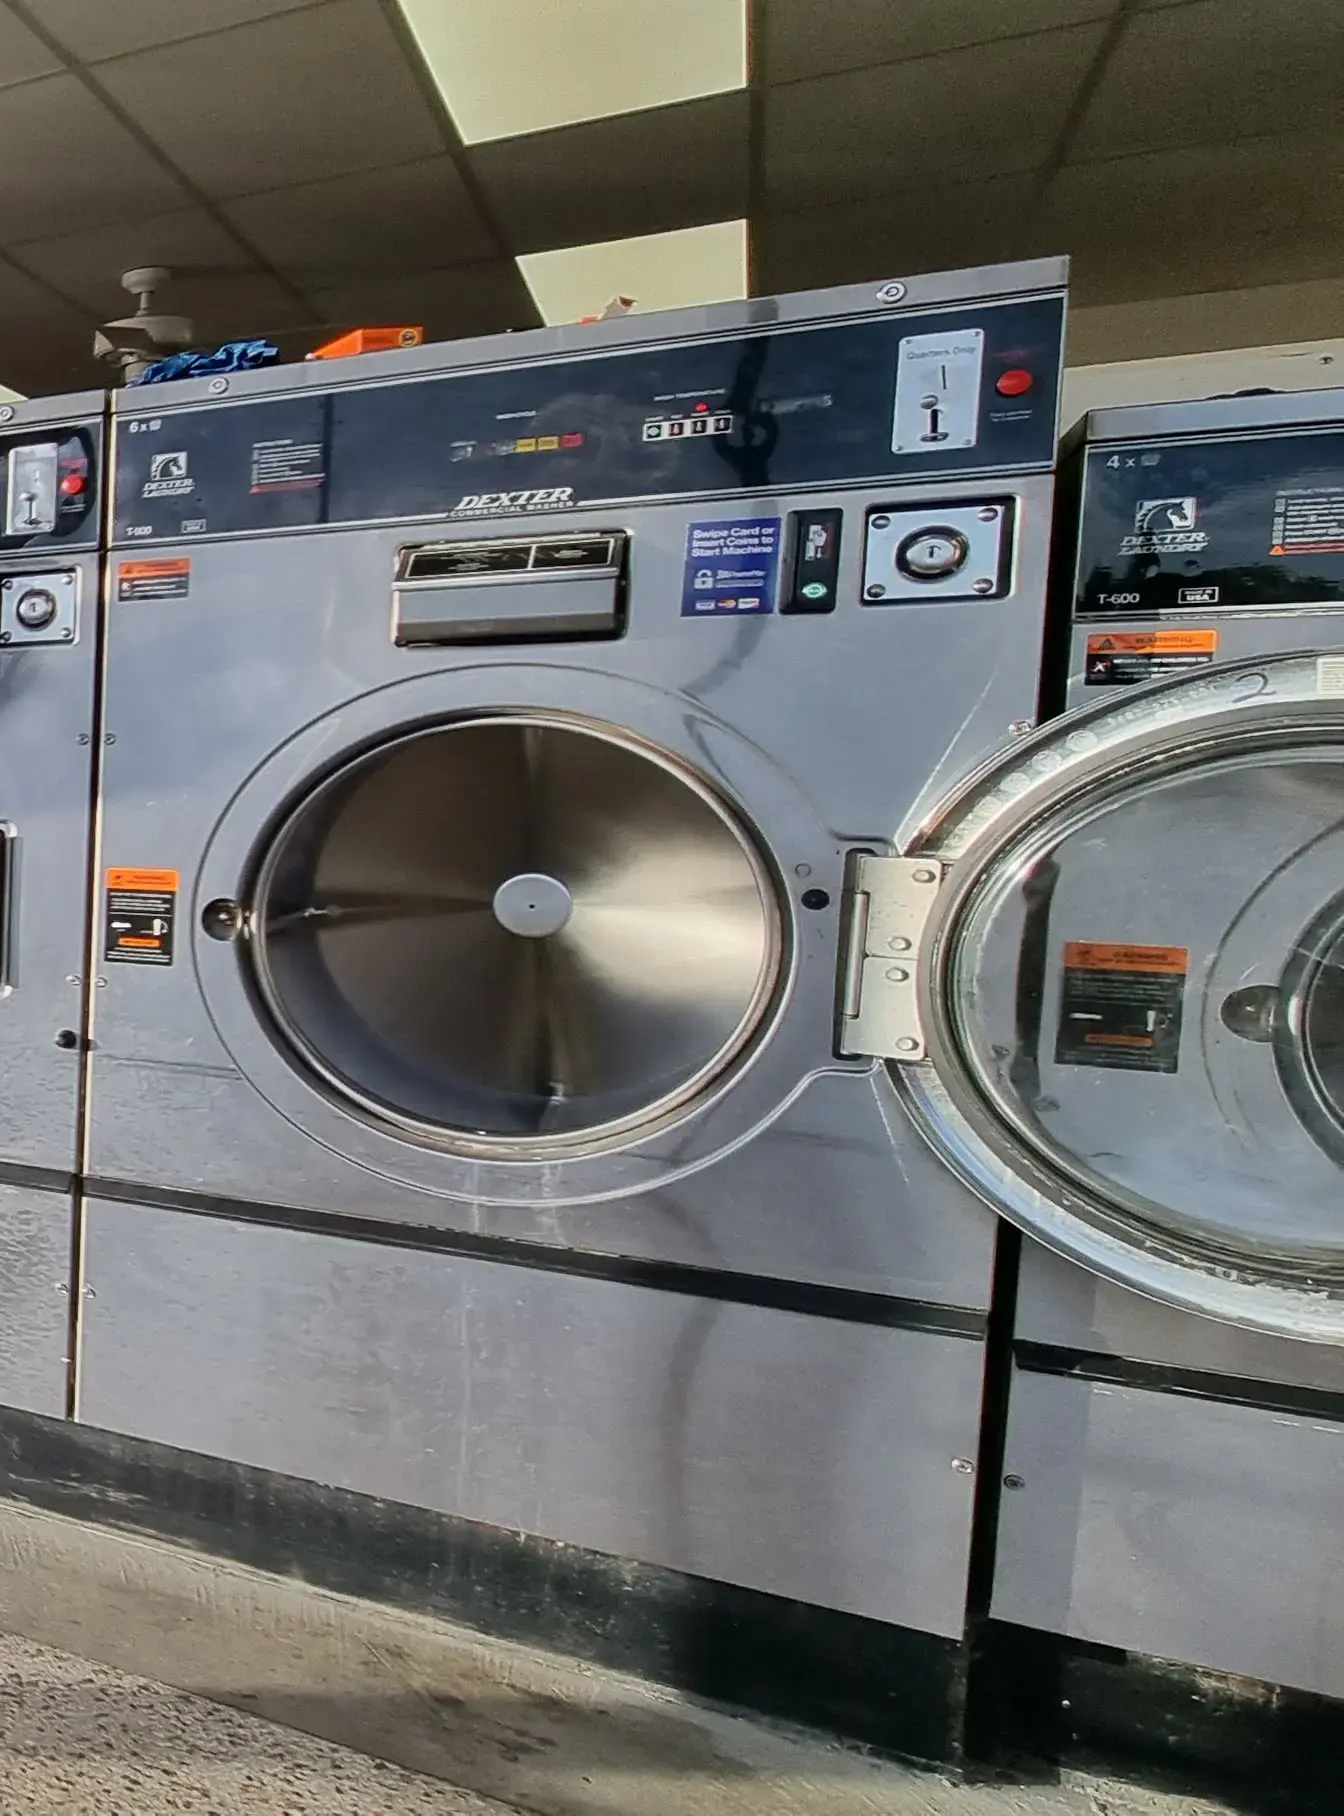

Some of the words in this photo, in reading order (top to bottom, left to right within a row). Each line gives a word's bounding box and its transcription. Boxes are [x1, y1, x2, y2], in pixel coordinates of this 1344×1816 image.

[906, 349, 950, 360] Quarters
[952, 346, 977, 356] Only
[1106, 455, 1121, 469] 4
[1124, 457, 1136, 468] x
[143, 479, 193, 491] DEXTER
[453, 487, 574, 511] DEXTER
[450, 504, 523, 518] COMMERCIAL
[526, 500, 575, 512] WASHER
[692, 529, 729, 539] Swipe
[730, 526, 760, 536] Card
[762, 527, 776, 536] or
[1119, 531, 1207, 547] DEXTER
[692, 538, 725, 548] Insert
[725, 537, 759, 547] Coins
[761, 536, 774, 545] to
[1118, 542, 1209, 556] LAUNDRY
[691, 547, 721, 557] Start
[722, 545, 773, 556] Machine
[1097, 592, 1140, 605] T-600
[1232, 672, 1277, 704] 2
